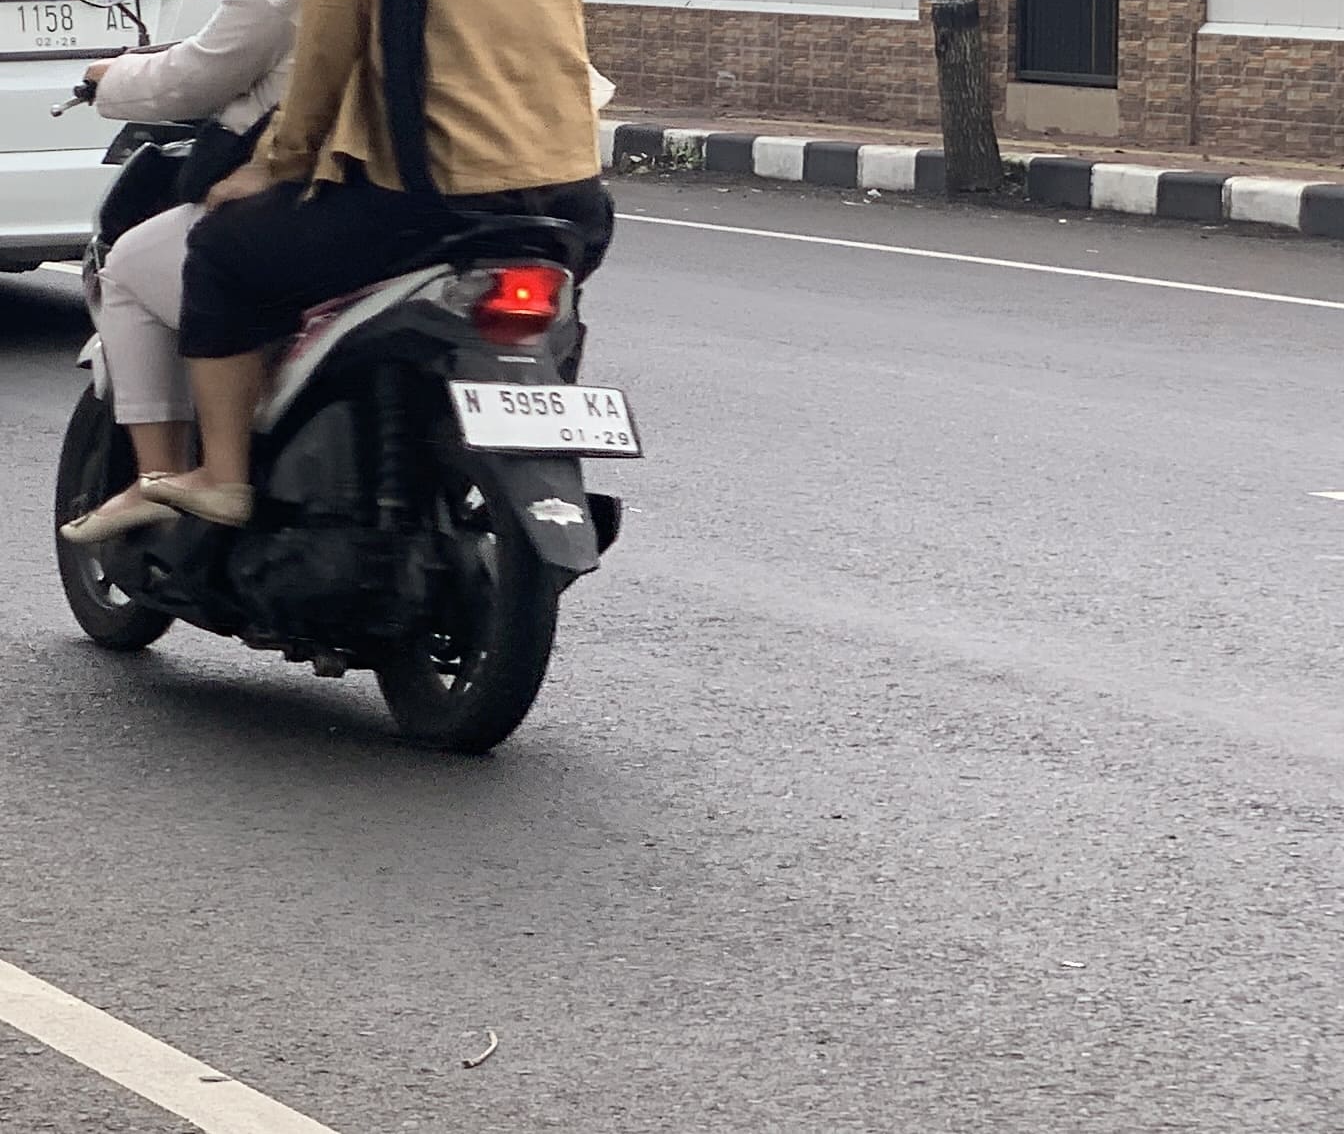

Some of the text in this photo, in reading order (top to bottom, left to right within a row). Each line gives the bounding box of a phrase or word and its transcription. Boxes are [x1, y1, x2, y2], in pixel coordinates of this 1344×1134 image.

[17, 4, 74, 33] 1158
[464, 389, 621, 418] N 5956 KA
